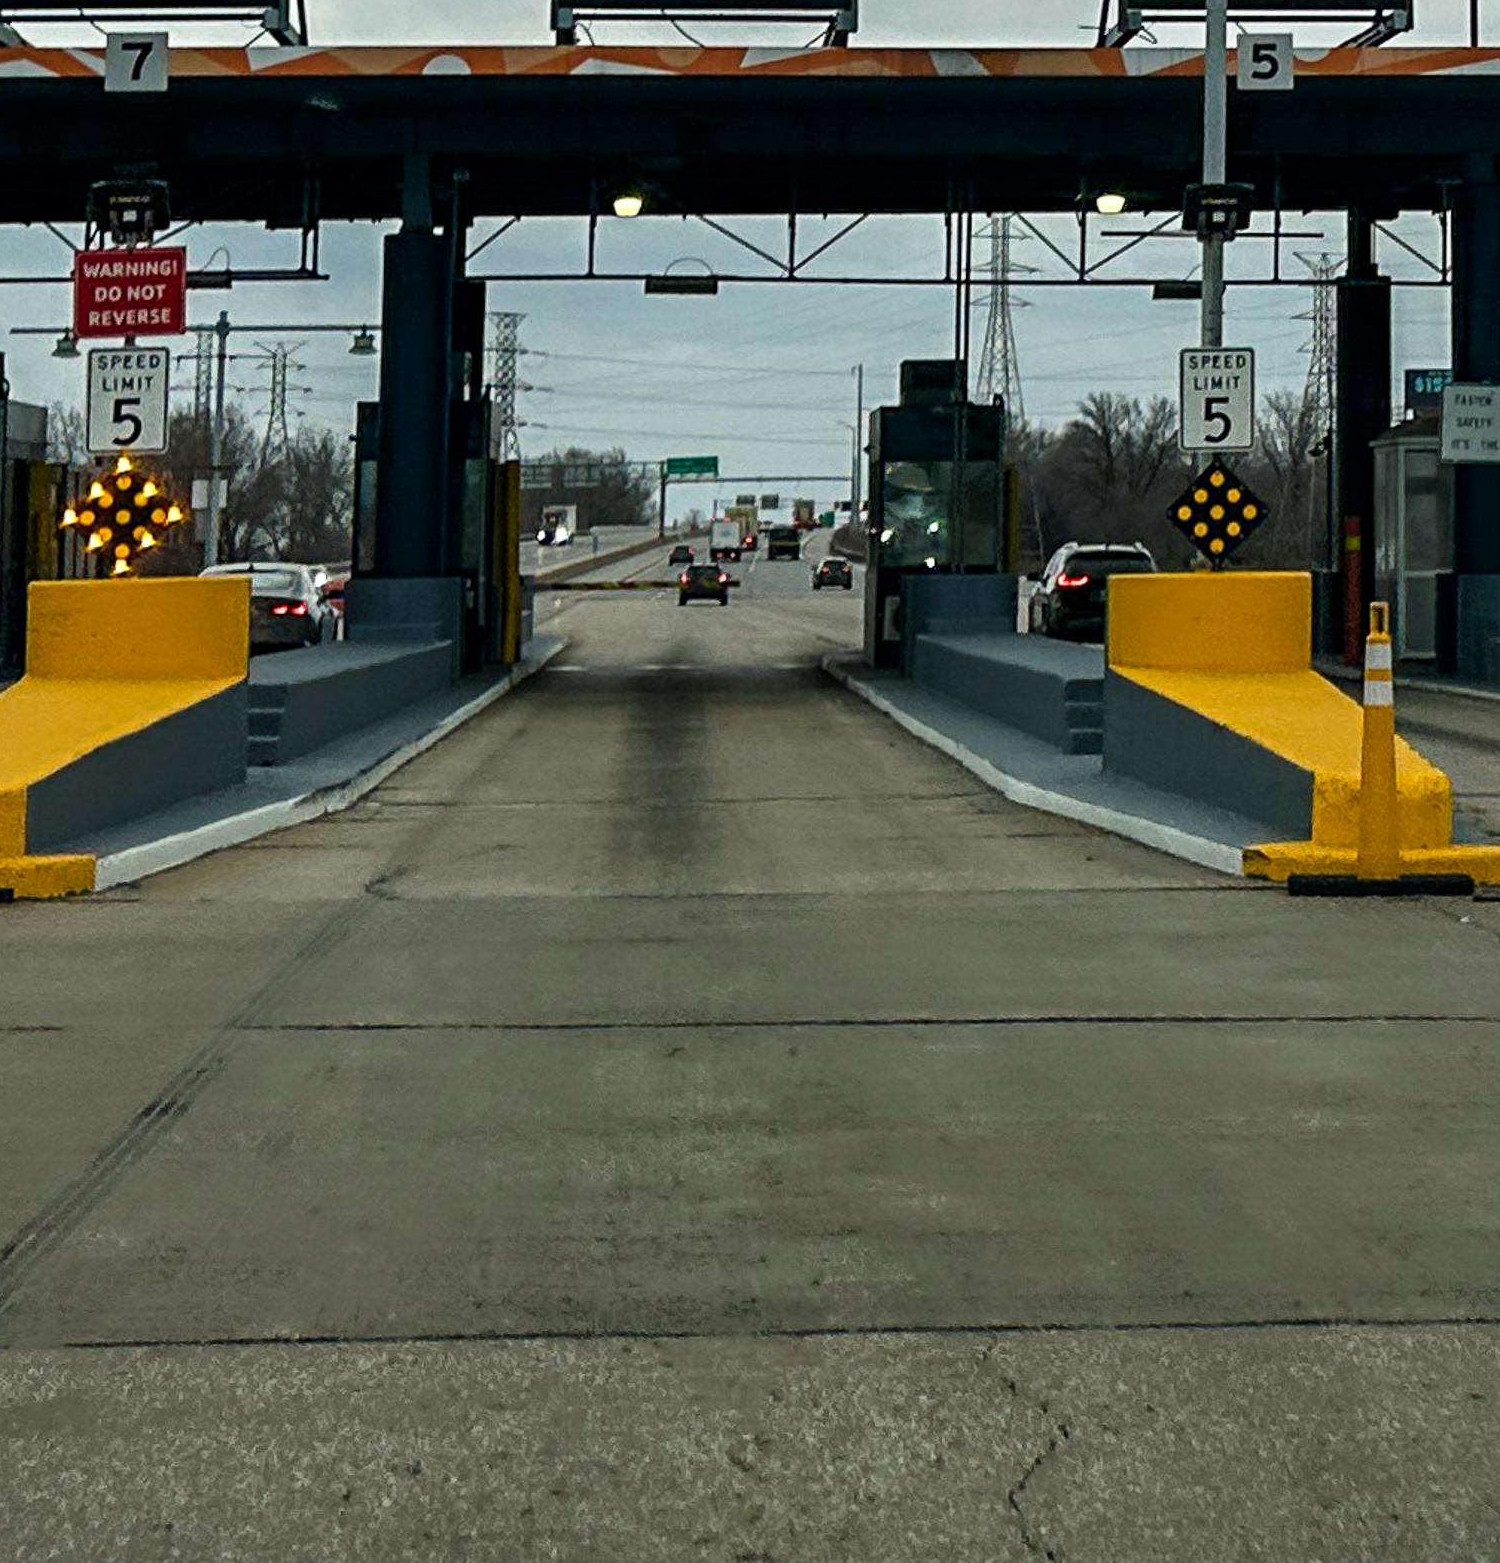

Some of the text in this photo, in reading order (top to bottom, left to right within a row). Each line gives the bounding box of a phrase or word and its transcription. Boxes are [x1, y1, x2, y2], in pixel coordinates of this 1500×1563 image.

[121, 41, 154, 82] 7
[1250, 42, 1280, 81] 5
[83, 259, 178, 279] WARNING!
[94, 284, 167, 303] DO NOT
[88, 308, 171, 327] REVERSE
[97, 354, 161, 372] SPEED
[1188, 354, 1247, 371] SPEED
[102, 375, 154, 393] LIMIT
[1193, 375, 1241, 392] LIMIT
[111, 397, 143, 447] 5
[1203, 396, 1232, 444] 5
